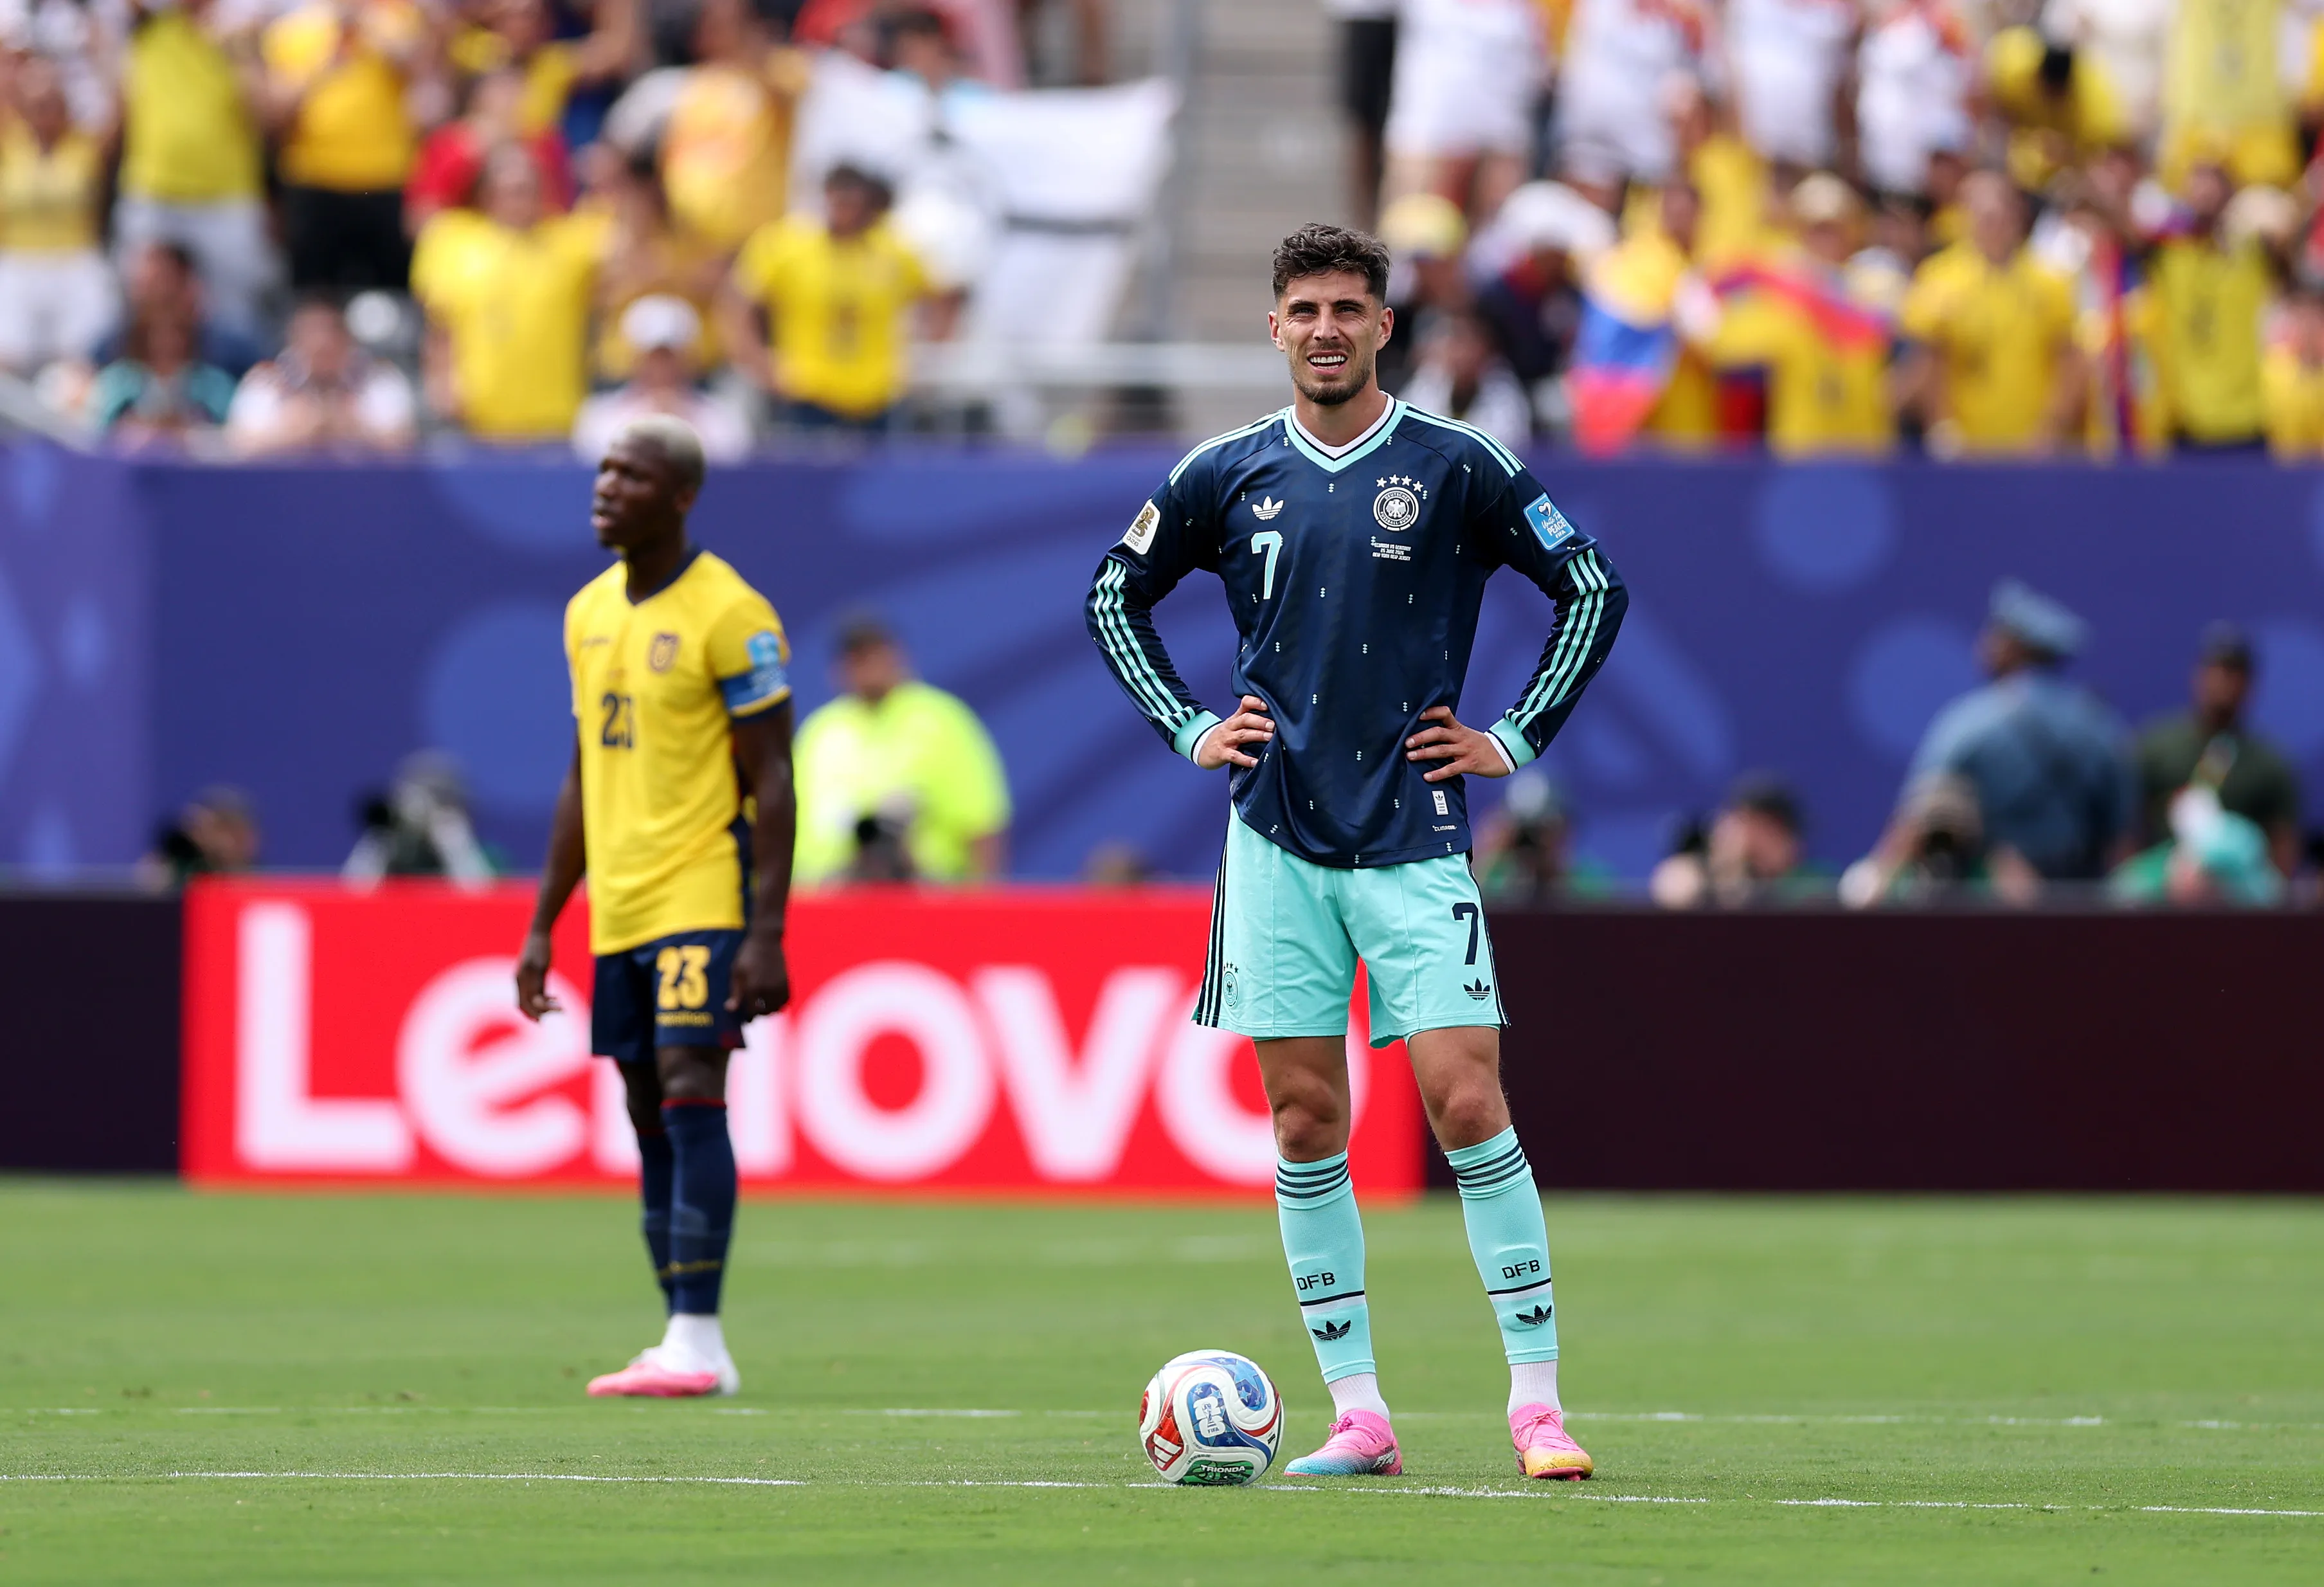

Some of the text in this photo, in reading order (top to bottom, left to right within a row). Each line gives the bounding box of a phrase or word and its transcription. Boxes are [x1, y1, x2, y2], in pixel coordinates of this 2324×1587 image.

[1547, 520, 1567, 536] PEACE
[1555, 529, 1566, 539] FIFA
[1250, 531, 1282, 600] 7
[600, 692, 633, 748] 23
[1452, 902, 1479, 965] 7
[656, 944, 712, 1010] 23
[1502, 1260, 1540, 1279] DFB
[1297, 1272, 1336, 1291] DFB
[1201, 1464, 1245, 1473] TRIONDA
